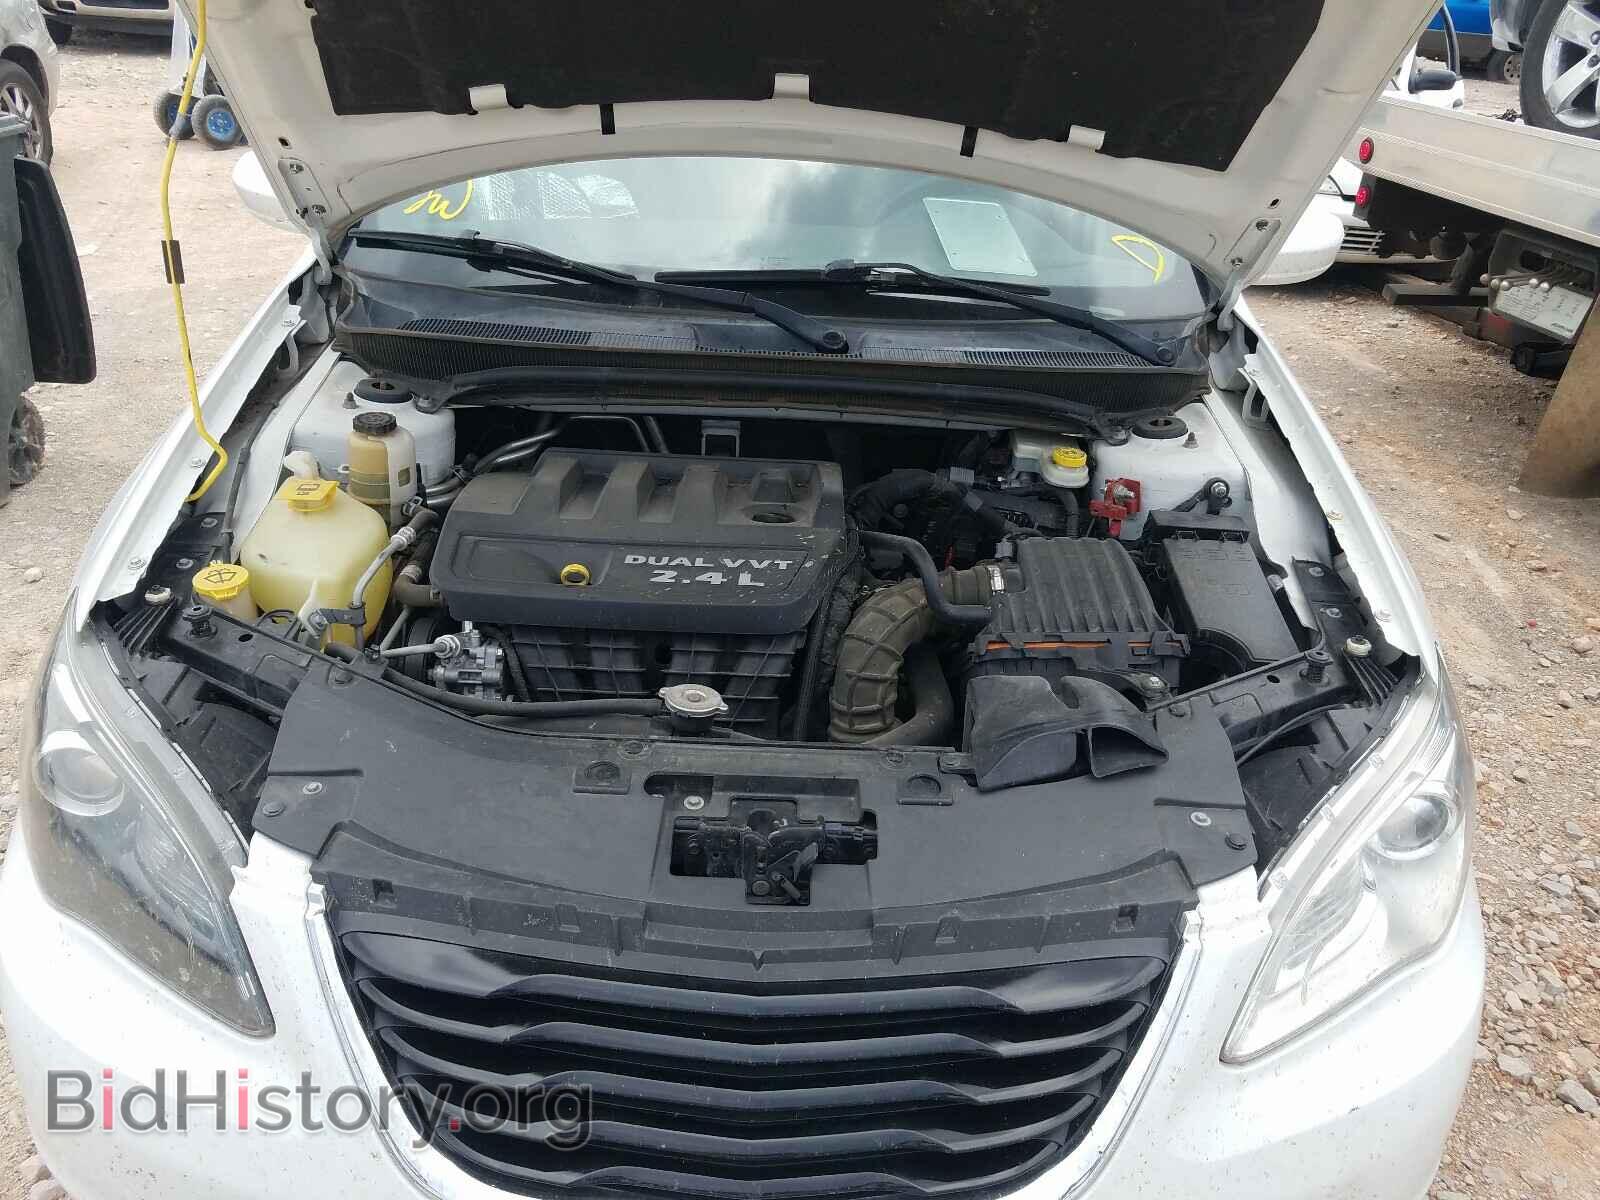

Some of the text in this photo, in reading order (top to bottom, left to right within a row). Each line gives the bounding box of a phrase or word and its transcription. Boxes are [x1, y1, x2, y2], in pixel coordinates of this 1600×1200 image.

[623, 554, 793, 570] DUAL VVT
[650, 569, 765, 587] 2.4 L
